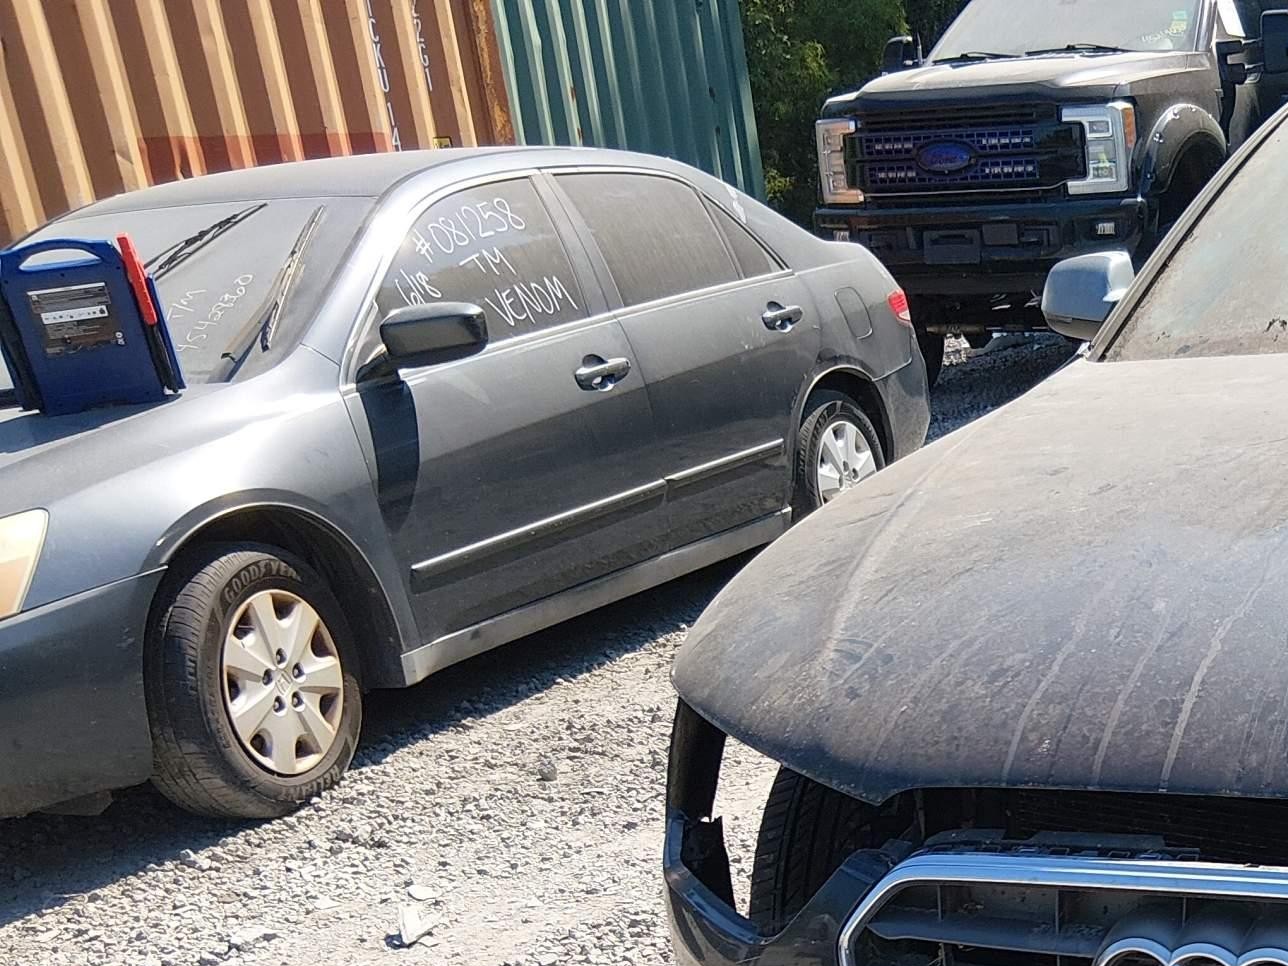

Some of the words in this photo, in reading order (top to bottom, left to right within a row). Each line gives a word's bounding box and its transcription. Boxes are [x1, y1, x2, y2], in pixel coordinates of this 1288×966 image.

[412, 197, 526, 263] #081258
[459, 246, 518, 277] TM
[484, 275, 579, 327] VENOM
